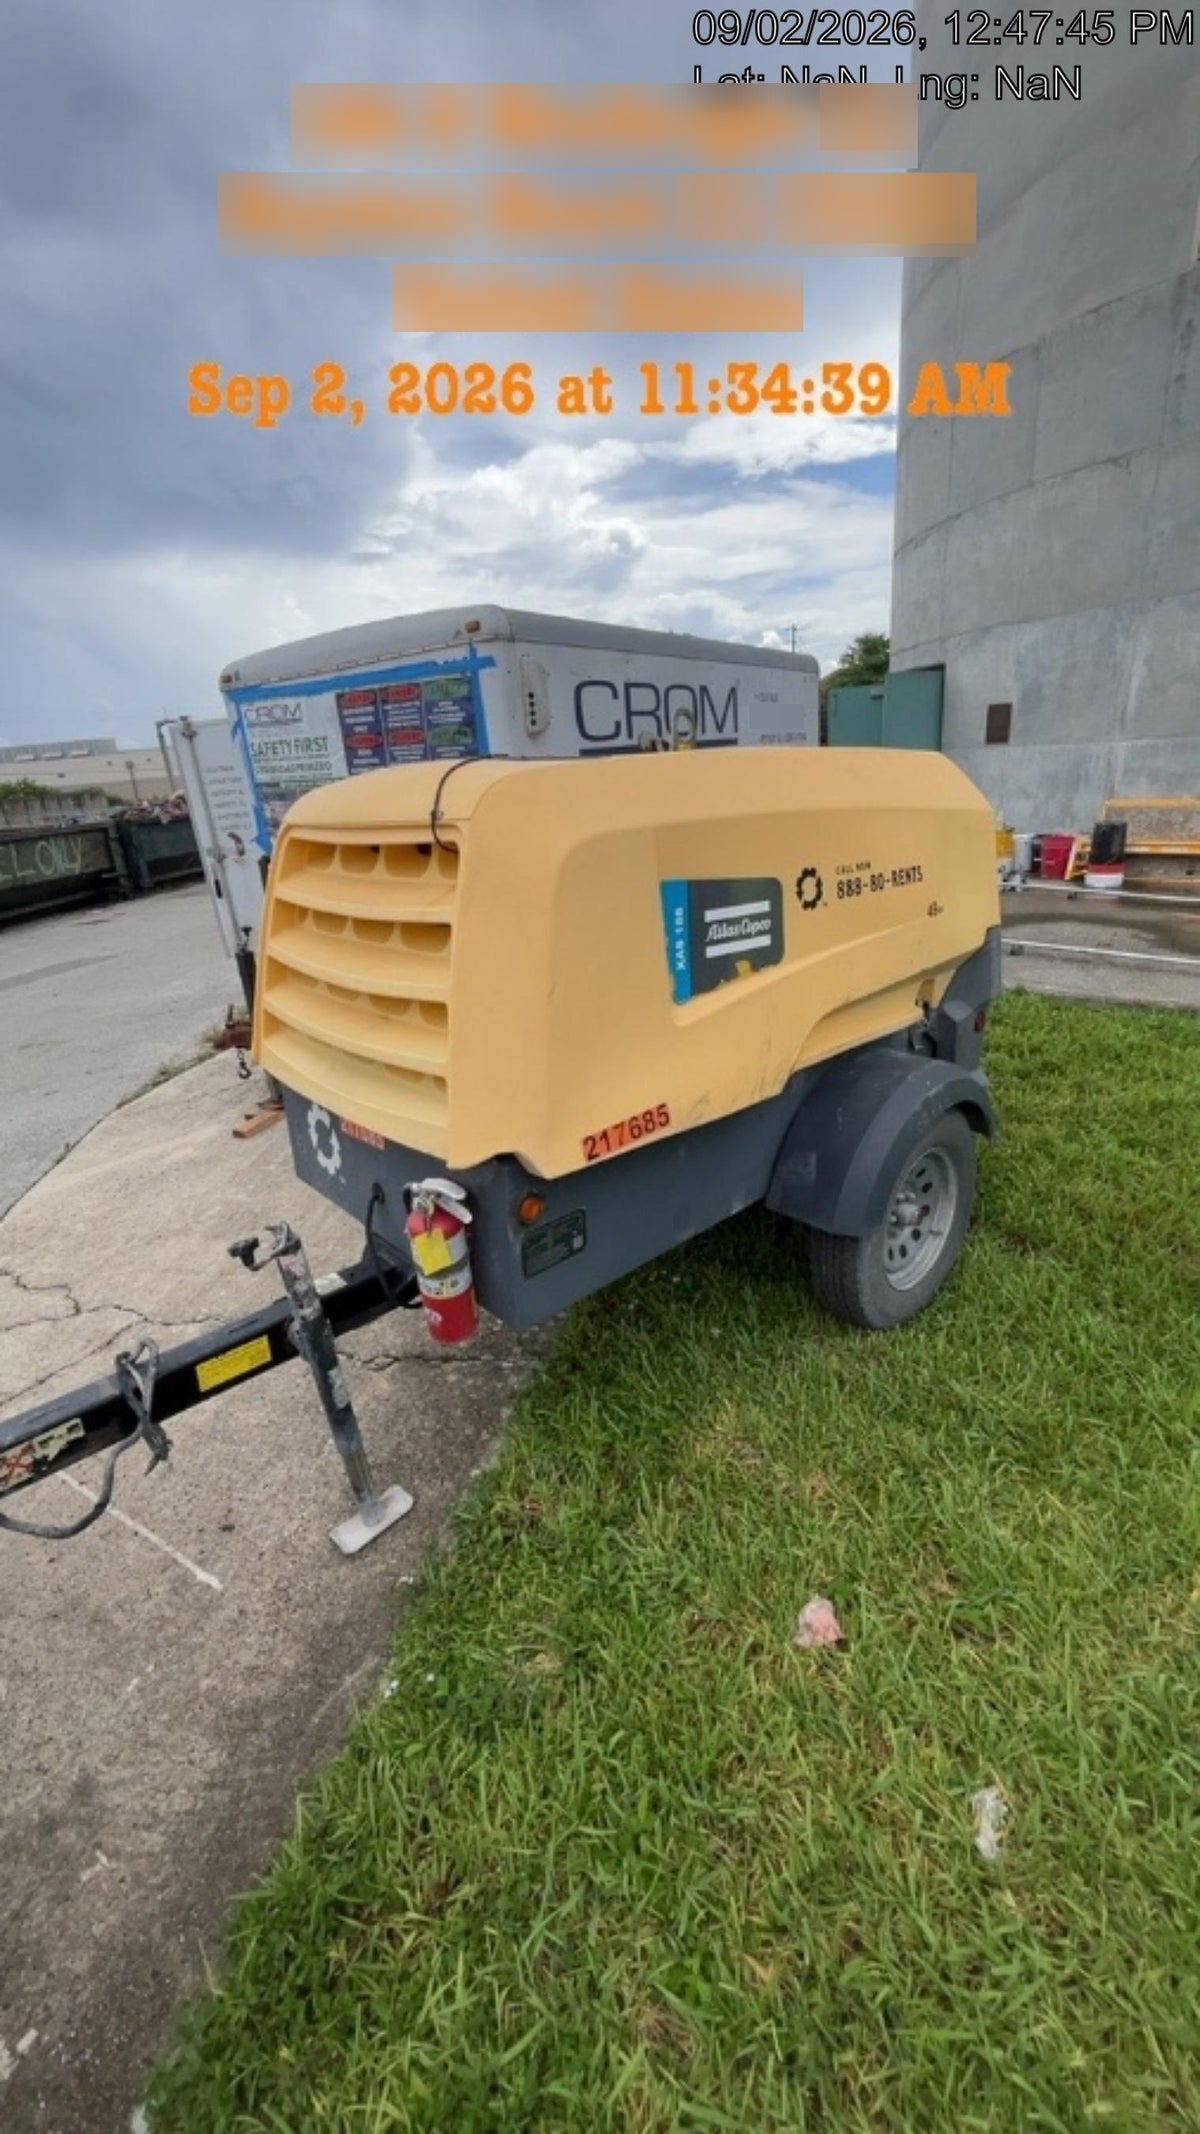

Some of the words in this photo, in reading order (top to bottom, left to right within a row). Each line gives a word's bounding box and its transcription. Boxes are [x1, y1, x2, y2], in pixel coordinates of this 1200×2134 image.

[245, 702, 302, 722] CROM
[574, 679, 739, 743] CROM
[250, 738, 293, 757] SAFETY
[293, 735, 329, 755] FIRST
[675, 938, 687, 971] XAS
[582, 1102, 671, 1161] 217685
